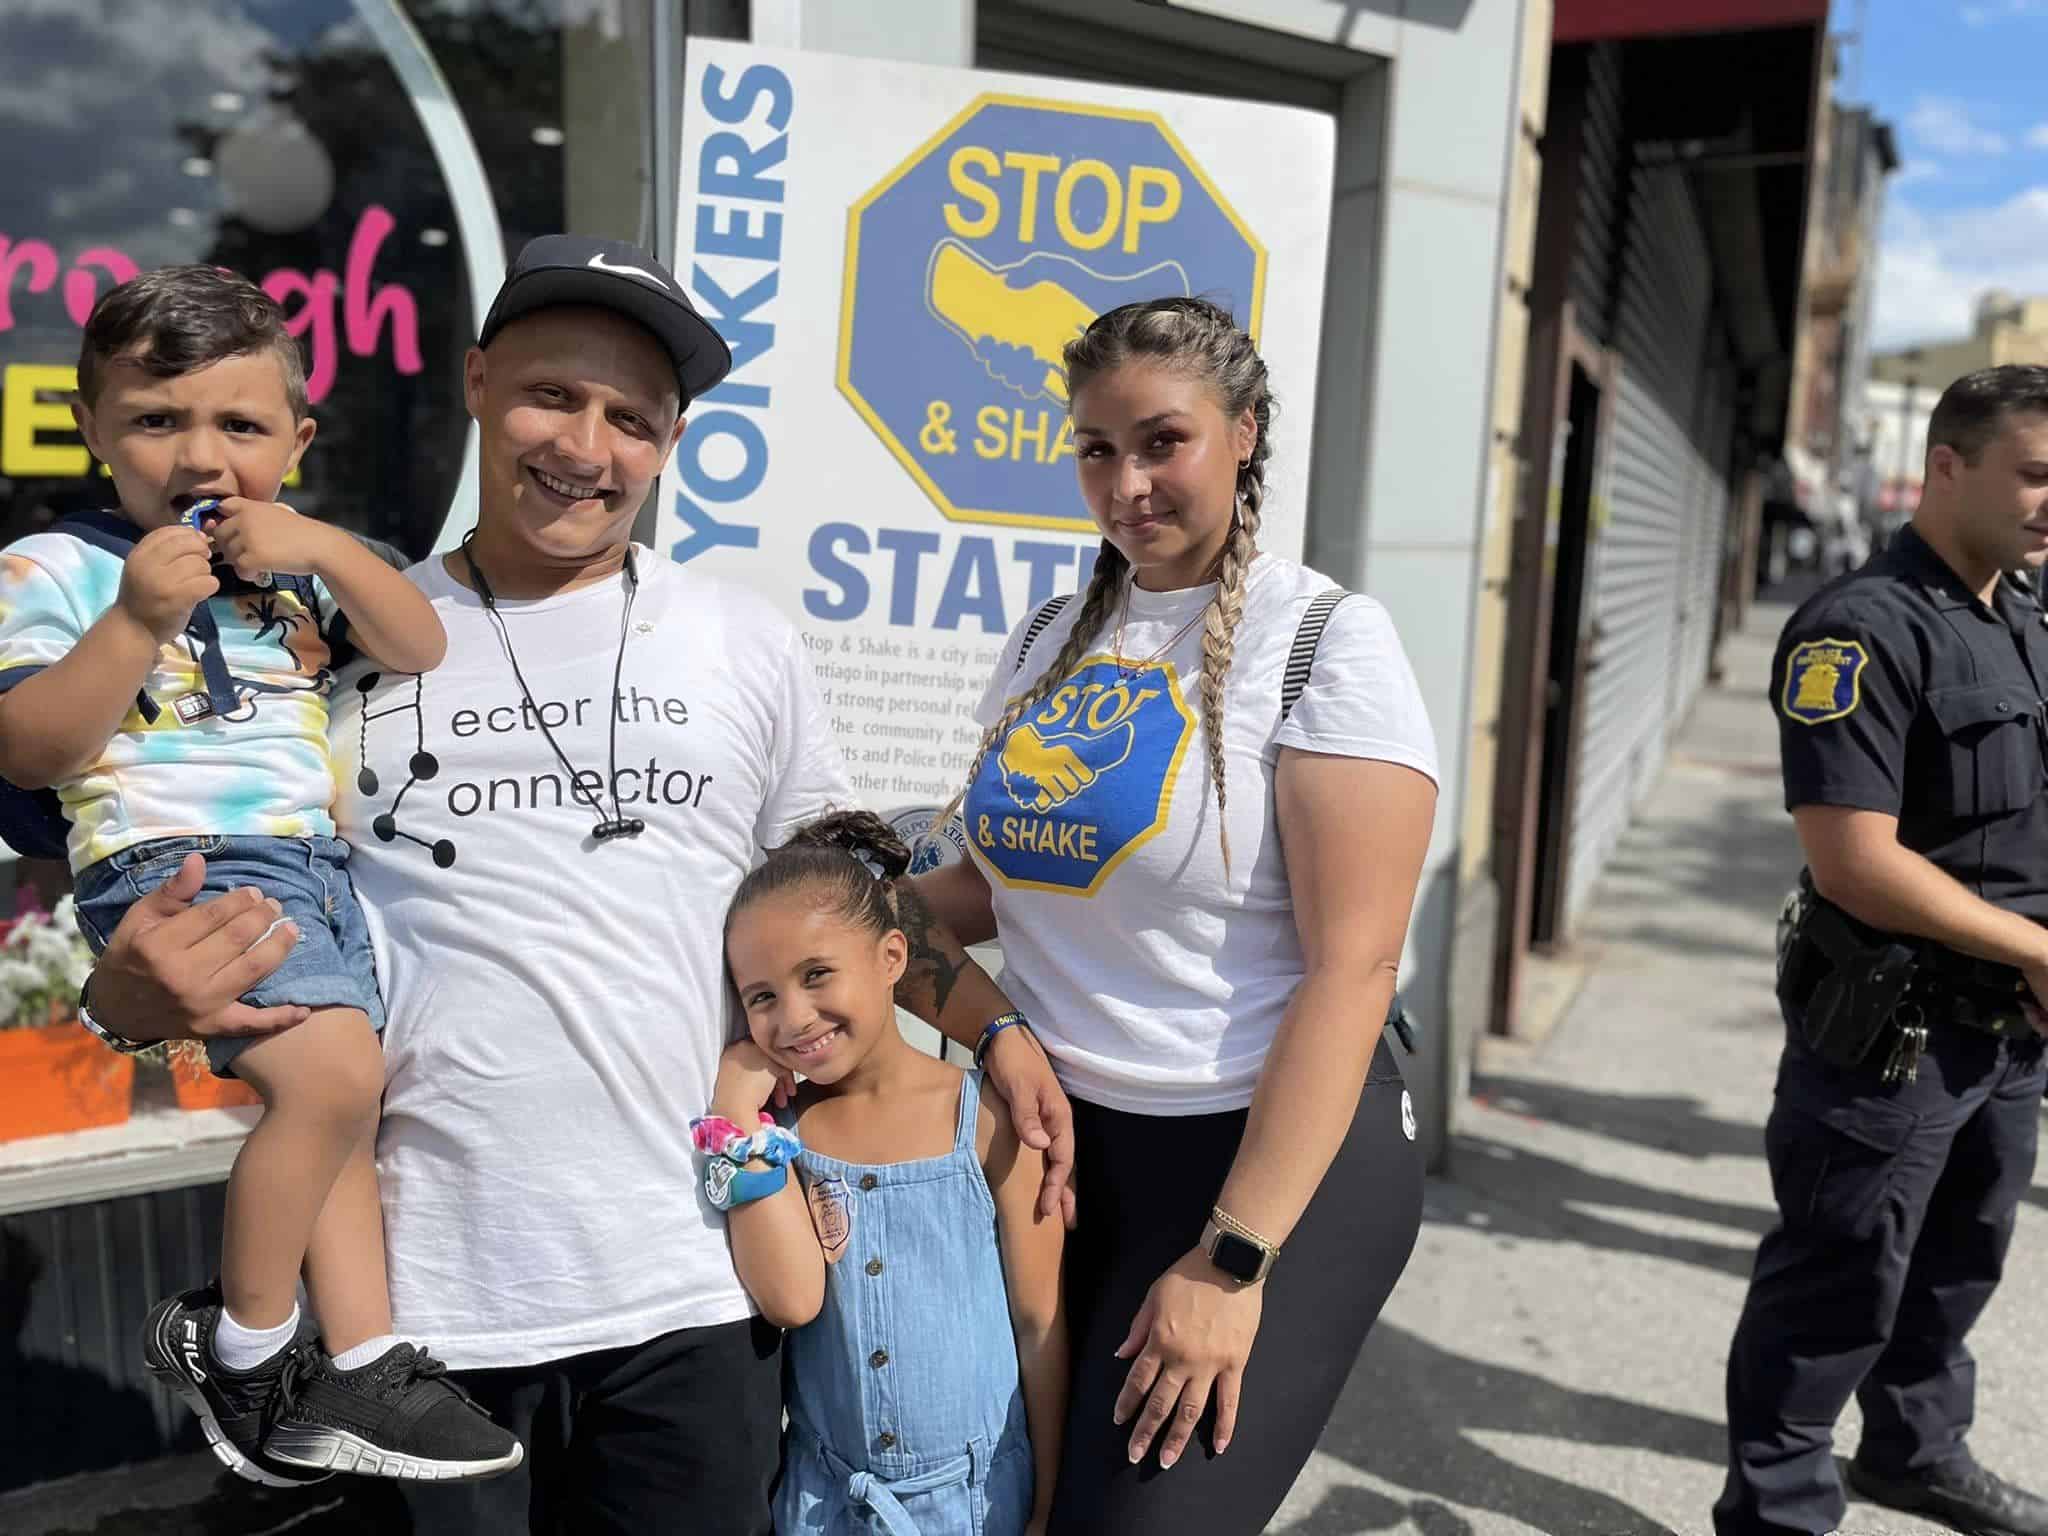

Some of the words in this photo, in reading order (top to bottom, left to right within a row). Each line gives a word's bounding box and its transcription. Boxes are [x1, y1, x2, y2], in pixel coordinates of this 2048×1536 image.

[943, 145, 1182, 254] STOP
[0, 204, 423, 405] rogh
[671, 62, 794, 565] YONKERS
[919, 400, 957, 455] &
[801, 631, 832, 655] Stop
[840, 634, 851, 654] &
[858, 637, 902, 657] Shake
[908, 641, 919, 659] is
[926, 647, 936, 661] a
[941, 646, 969, 668] city
[864, 664, 878, 681] in
[881, 667, 965, 694] partnership
[616, 686, 689, 726] the
[837, 692, 884, 713] strong
[888, 696, 952, 715] personal
[831, 716, 856, 734] the
[863, 722, 945, 744] community
[862, 748, 890, 764] and
[894, 747, 937, 768] Police
[977, 814, 996, 851] &
[1002, 817, 1099, 862] SHAKE
[183, 1319, 207, 1383] FILA
